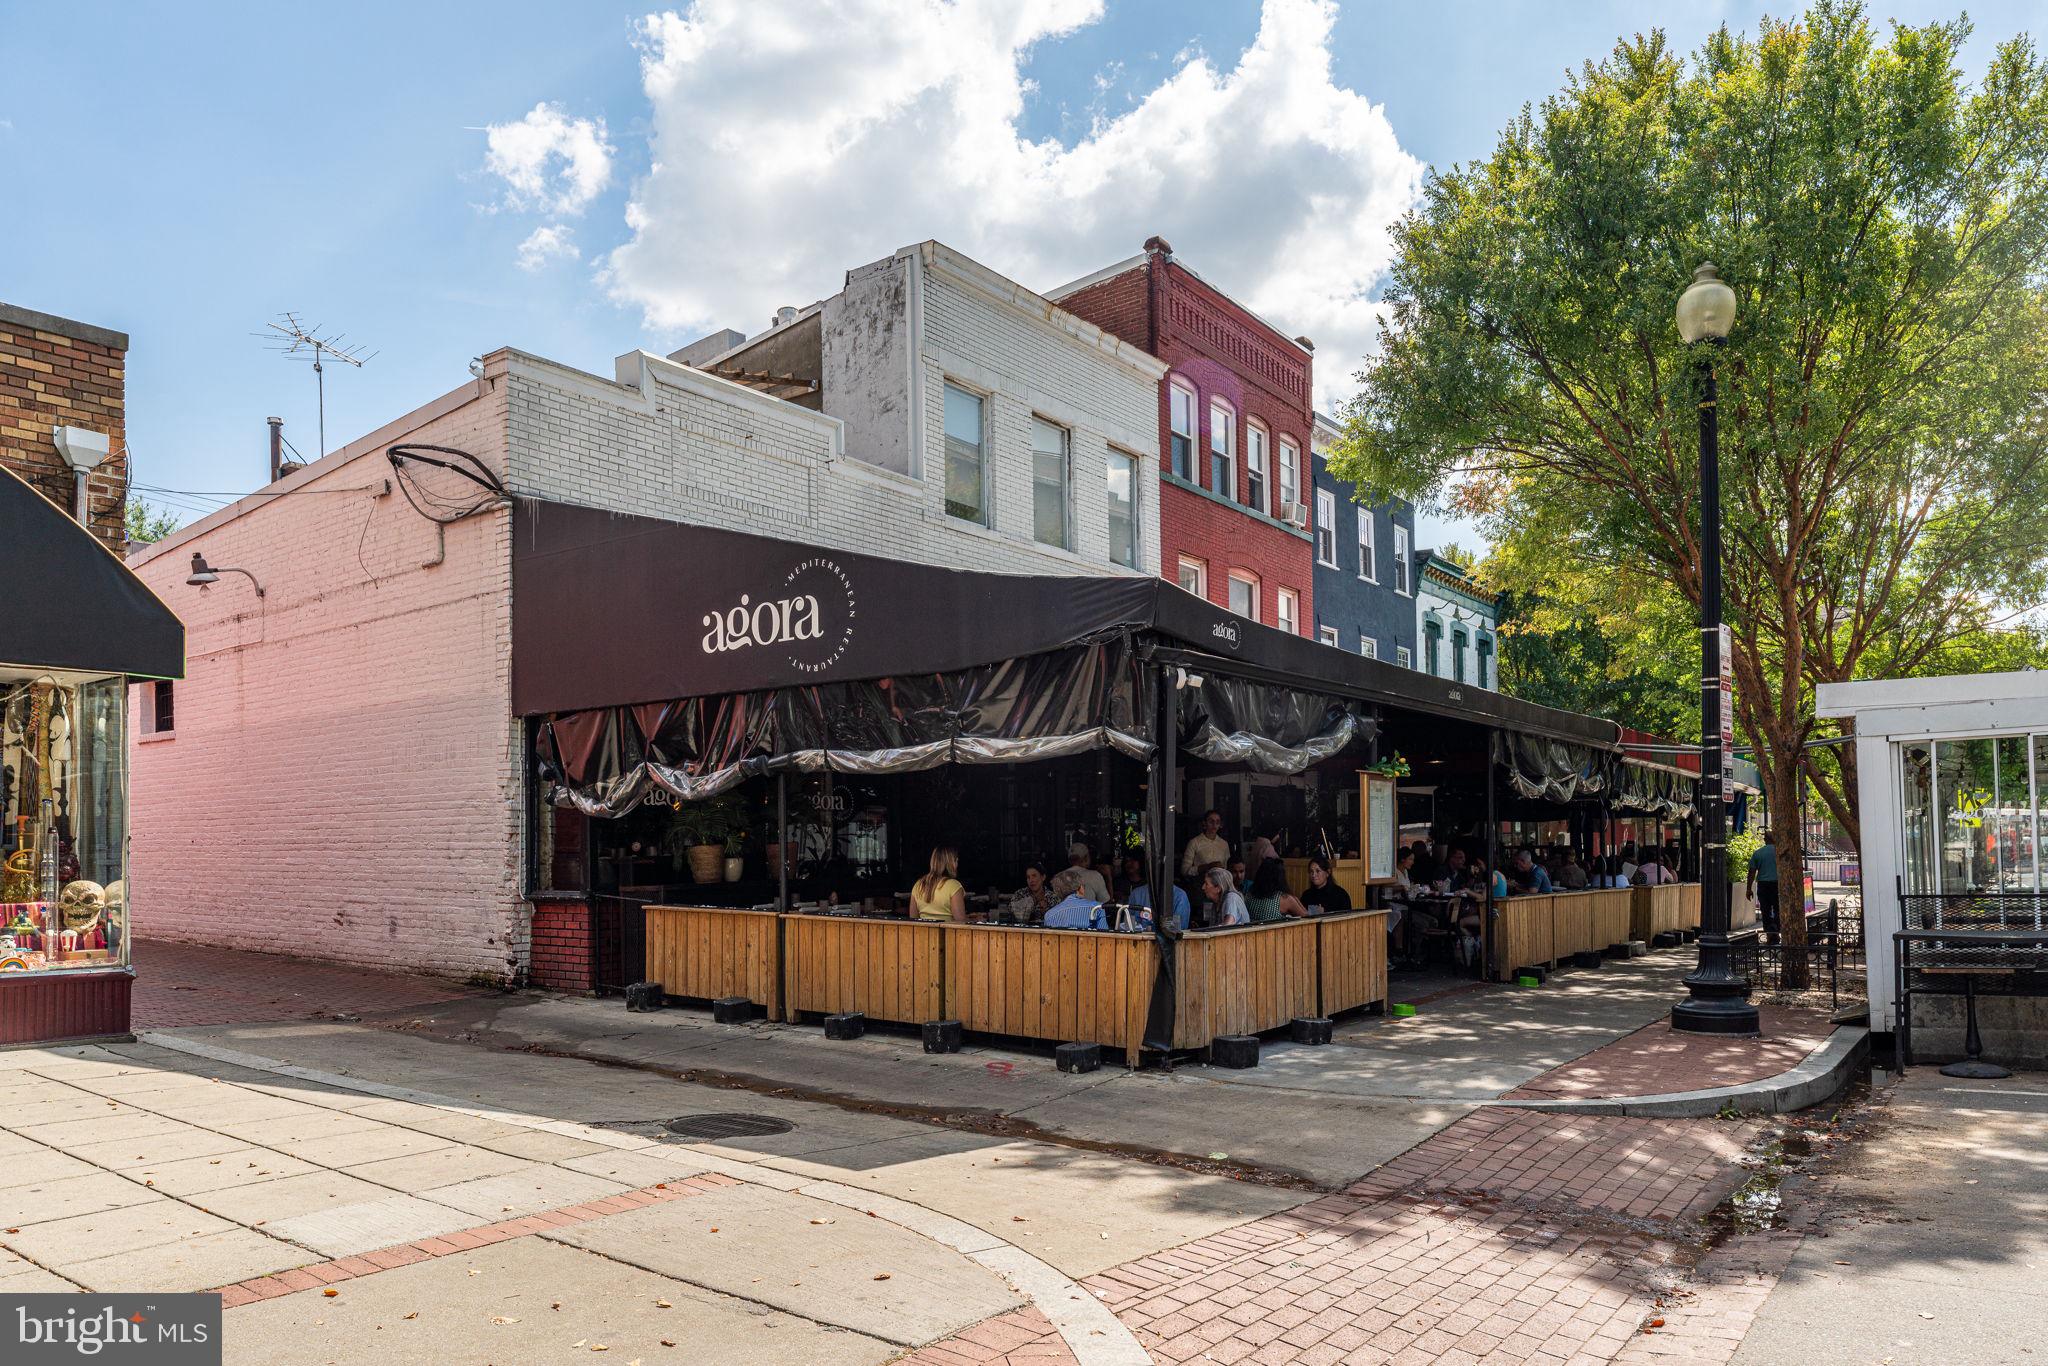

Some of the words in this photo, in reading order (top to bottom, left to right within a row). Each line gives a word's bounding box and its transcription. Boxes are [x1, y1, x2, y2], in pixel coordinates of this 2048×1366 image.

[787, 558, 856, 618] MEDITERRANEAN
[702, 594, 824, 654] agora
[791, 628, 853, 672] RESTAURANT
